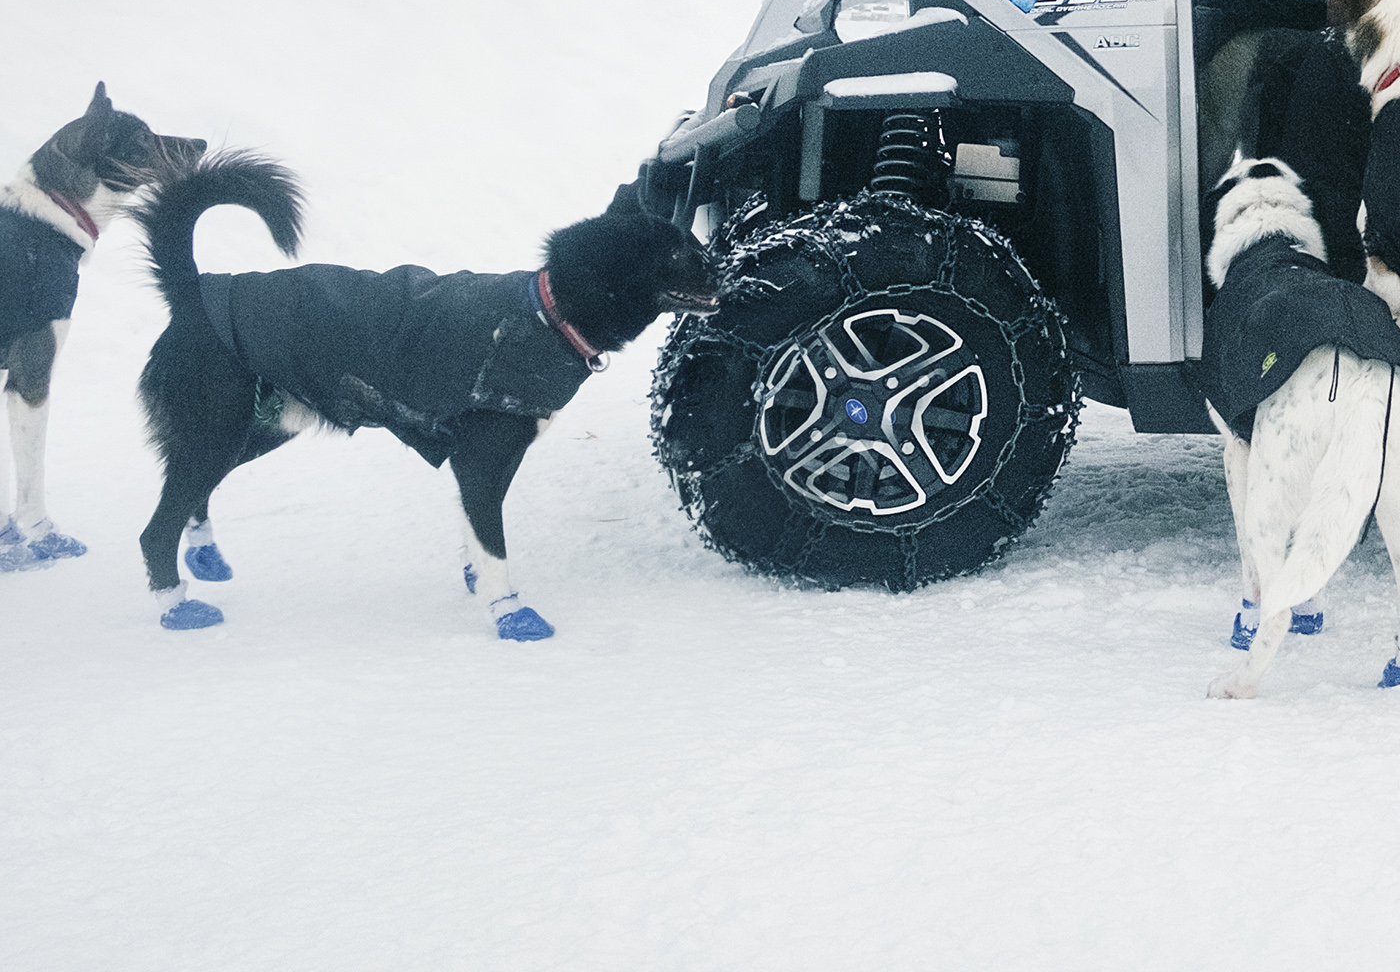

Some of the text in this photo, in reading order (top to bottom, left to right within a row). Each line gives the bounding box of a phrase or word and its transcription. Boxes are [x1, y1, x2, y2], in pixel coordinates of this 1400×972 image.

[1029, 7, 1055, 15] DUAL
[1056, 3, 1105, 13] OVERHEAD
[1093, 34, 1140, 49] ADC
